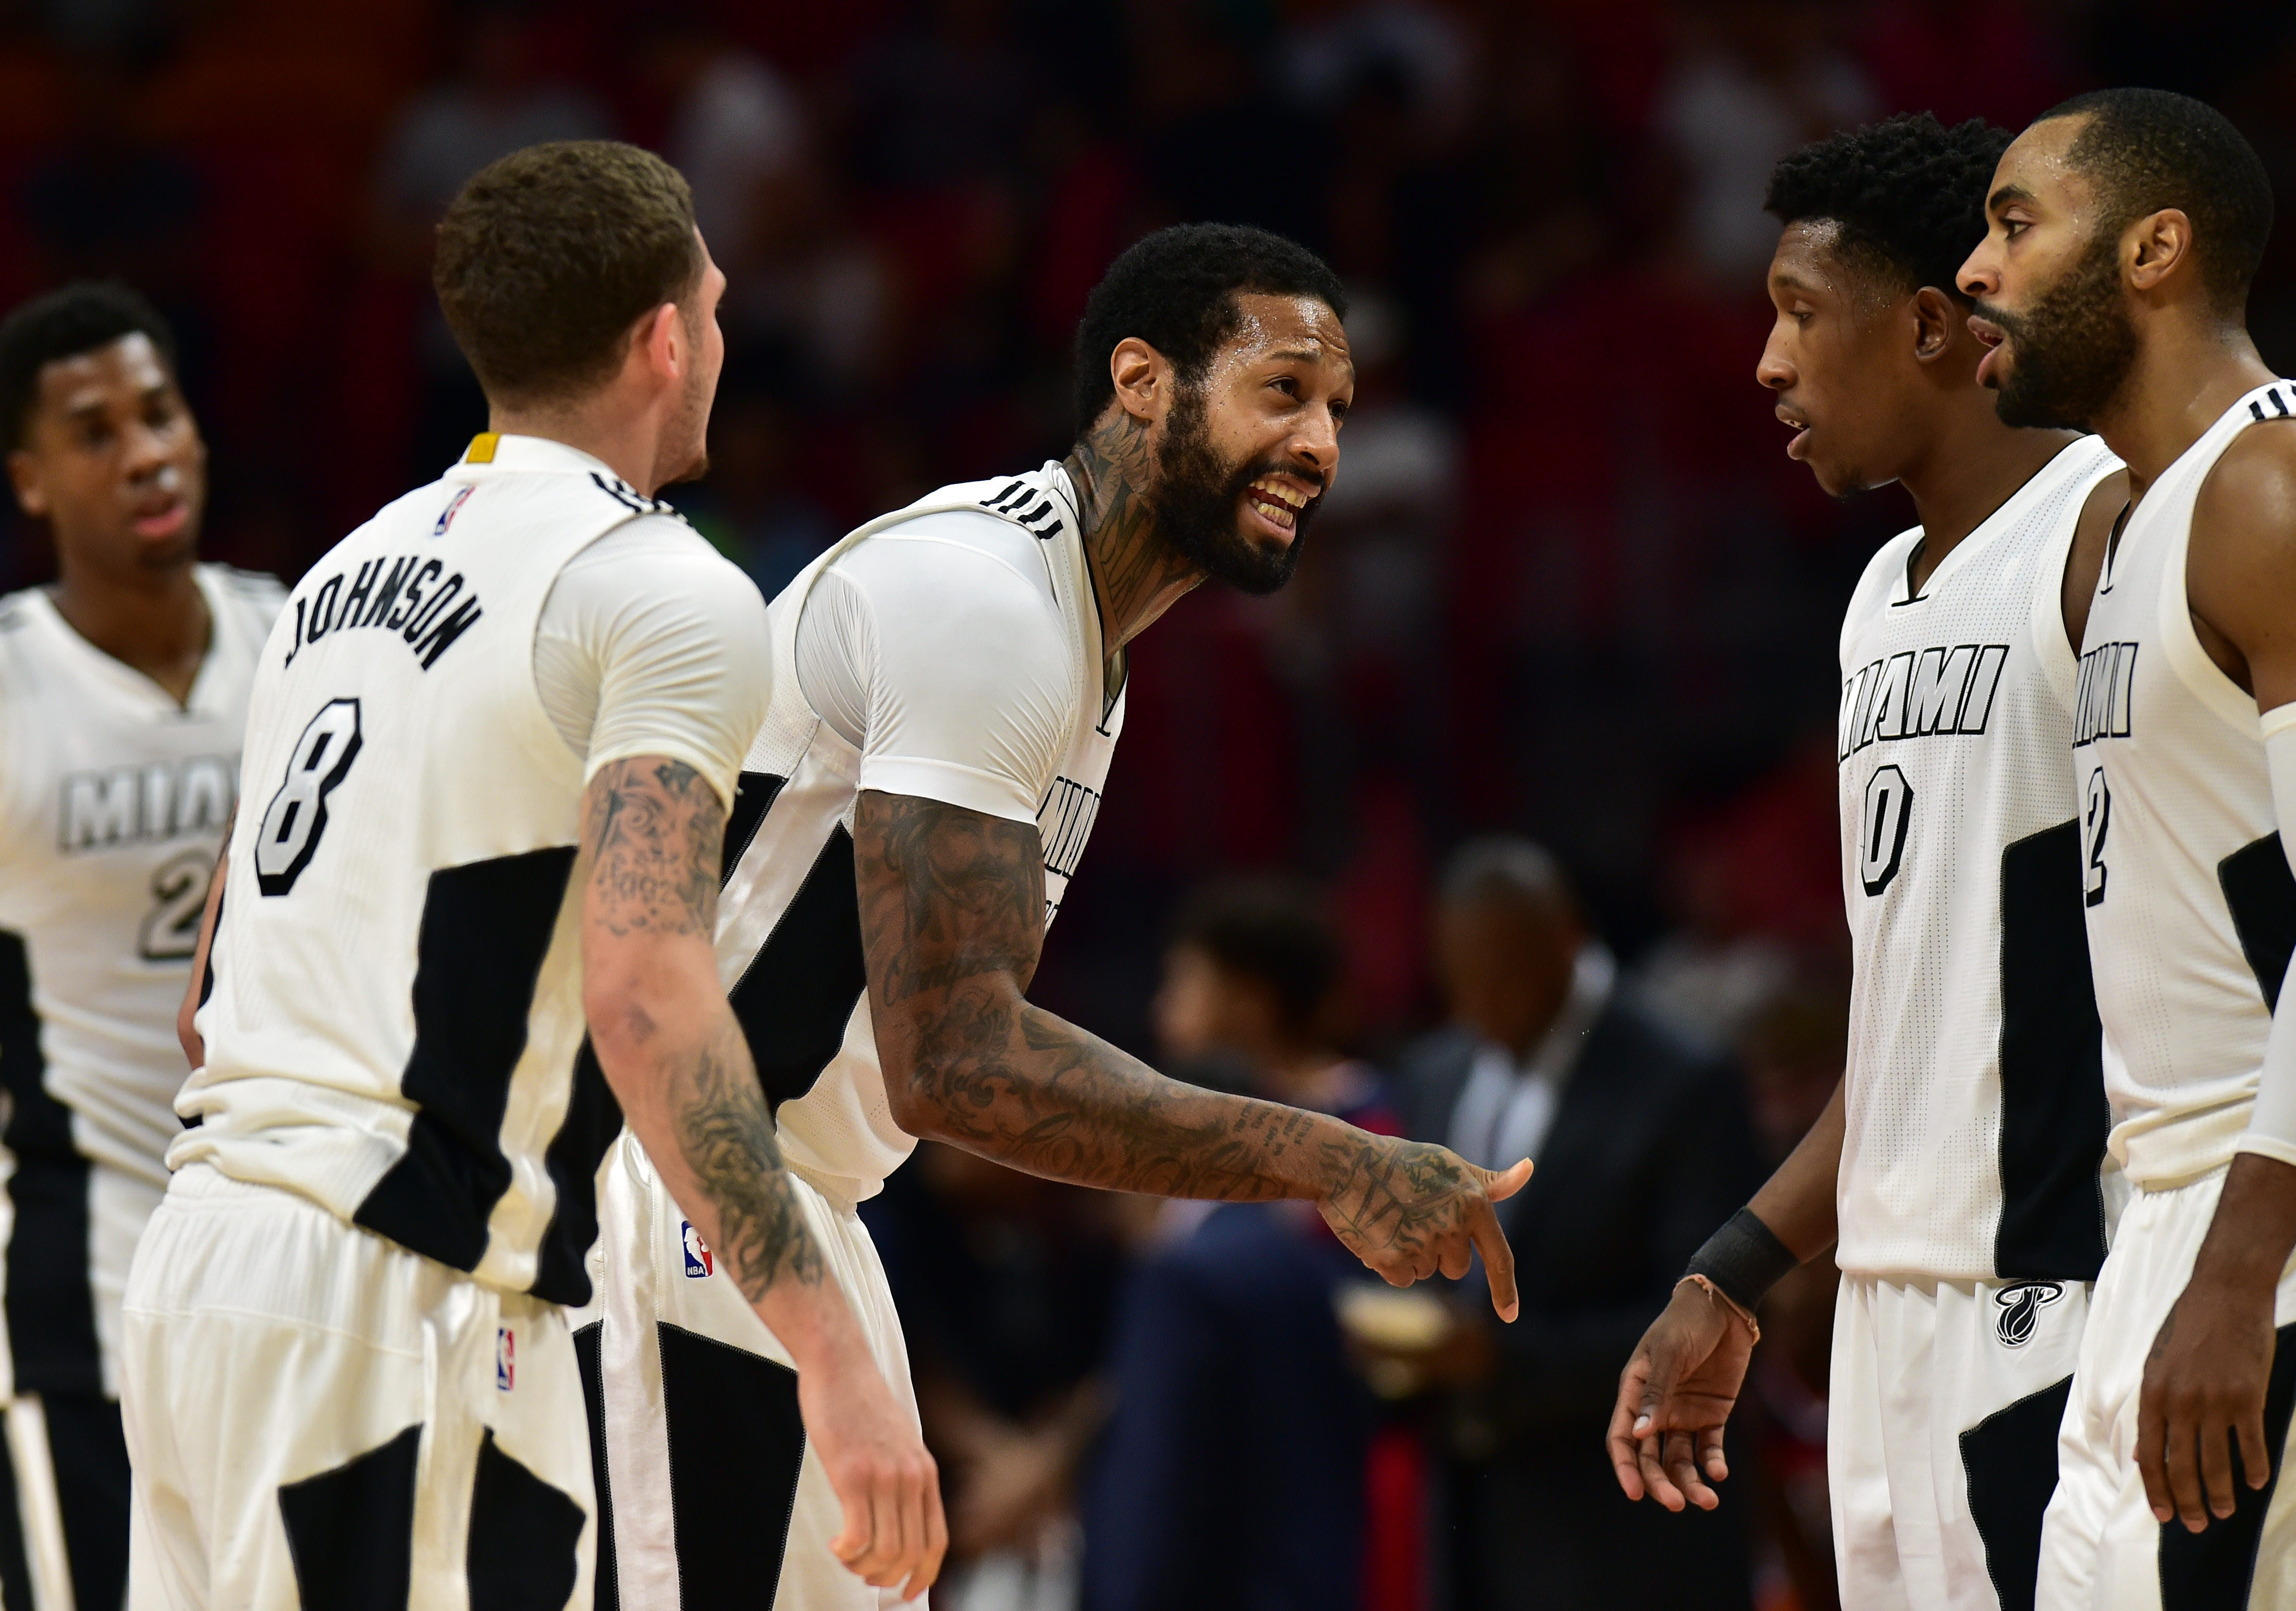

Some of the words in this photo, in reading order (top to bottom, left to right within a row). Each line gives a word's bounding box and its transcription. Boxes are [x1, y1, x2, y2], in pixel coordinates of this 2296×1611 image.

[284, 556, 483, 673] JOHNSON
[58, 752, 243, 858] MIA
[255, 697, 363, 897] 8
[1861, 764, 1914, 897] 0
[2086, 766, 2111, 908] 2
[687, 1266, 704, 1276] NBA
